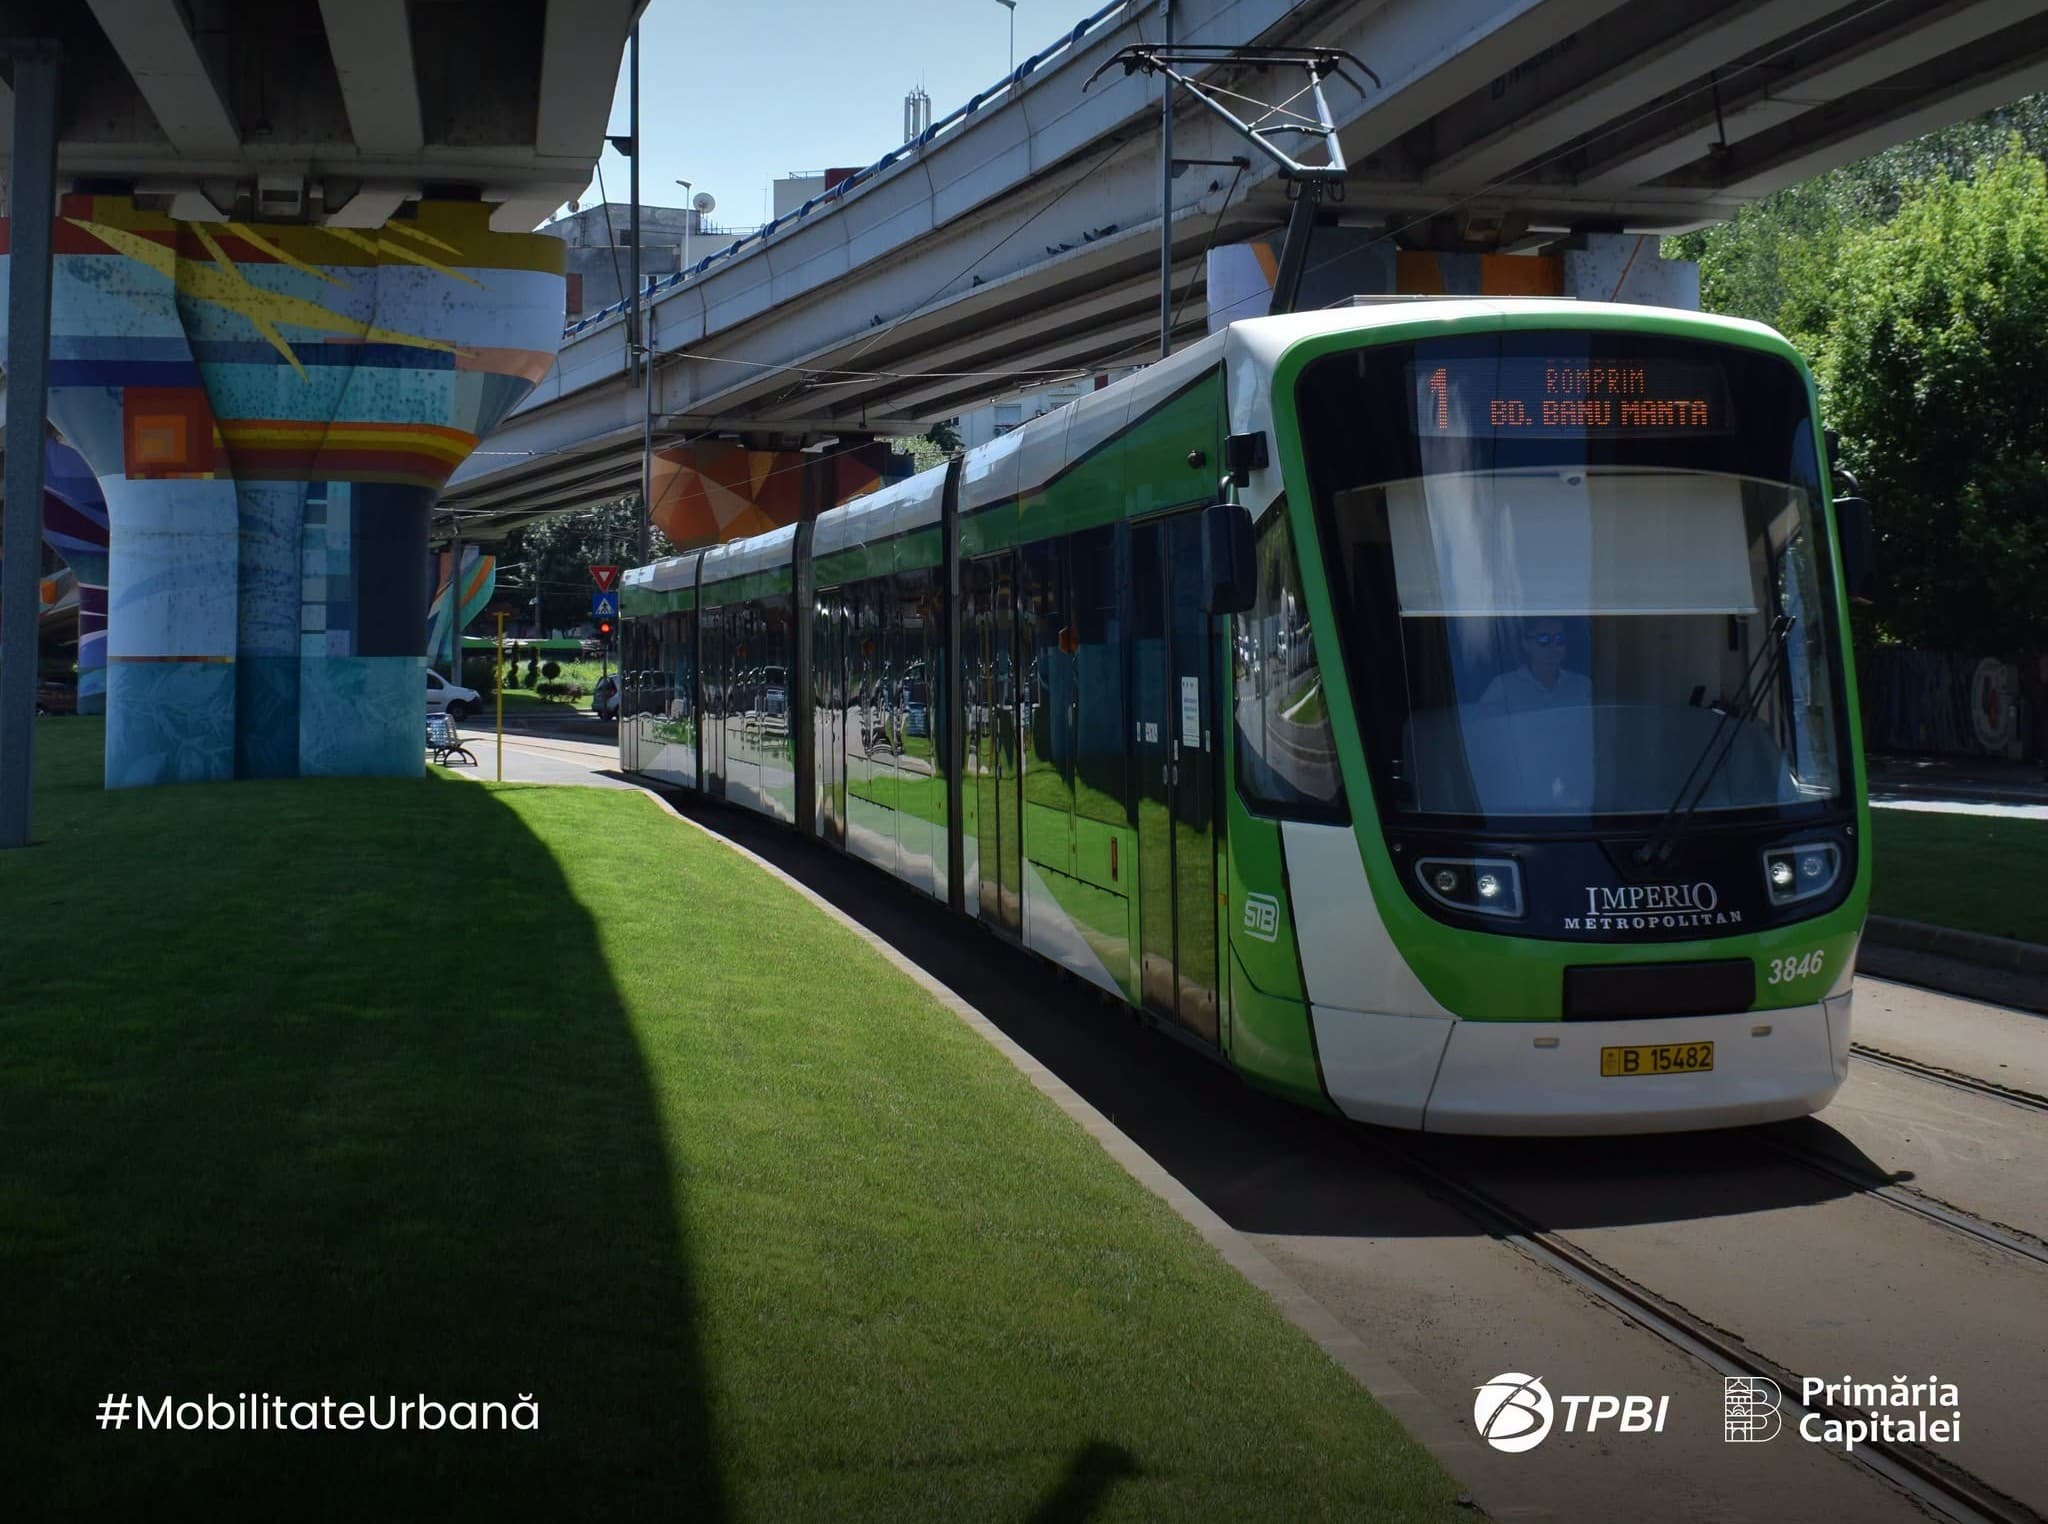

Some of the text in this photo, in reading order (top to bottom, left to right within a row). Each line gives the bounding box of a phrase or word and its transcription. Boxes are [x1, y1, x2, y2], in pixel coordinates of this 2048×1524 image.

[1430, 368, 1447, 428] 1
[1543, 400, 1611, 425] BANU
[1621, 400, 1708, 425] MANTA
[1585, 882, 1718, 916] IMPERIO
[1245, 900, 1276, 931] STB
[1564, 911, 1743, 929] METROPOLITAN
[1768, 949, 1825, 985] 3846
[1623, 1046, 1711, 1072] B 15482
